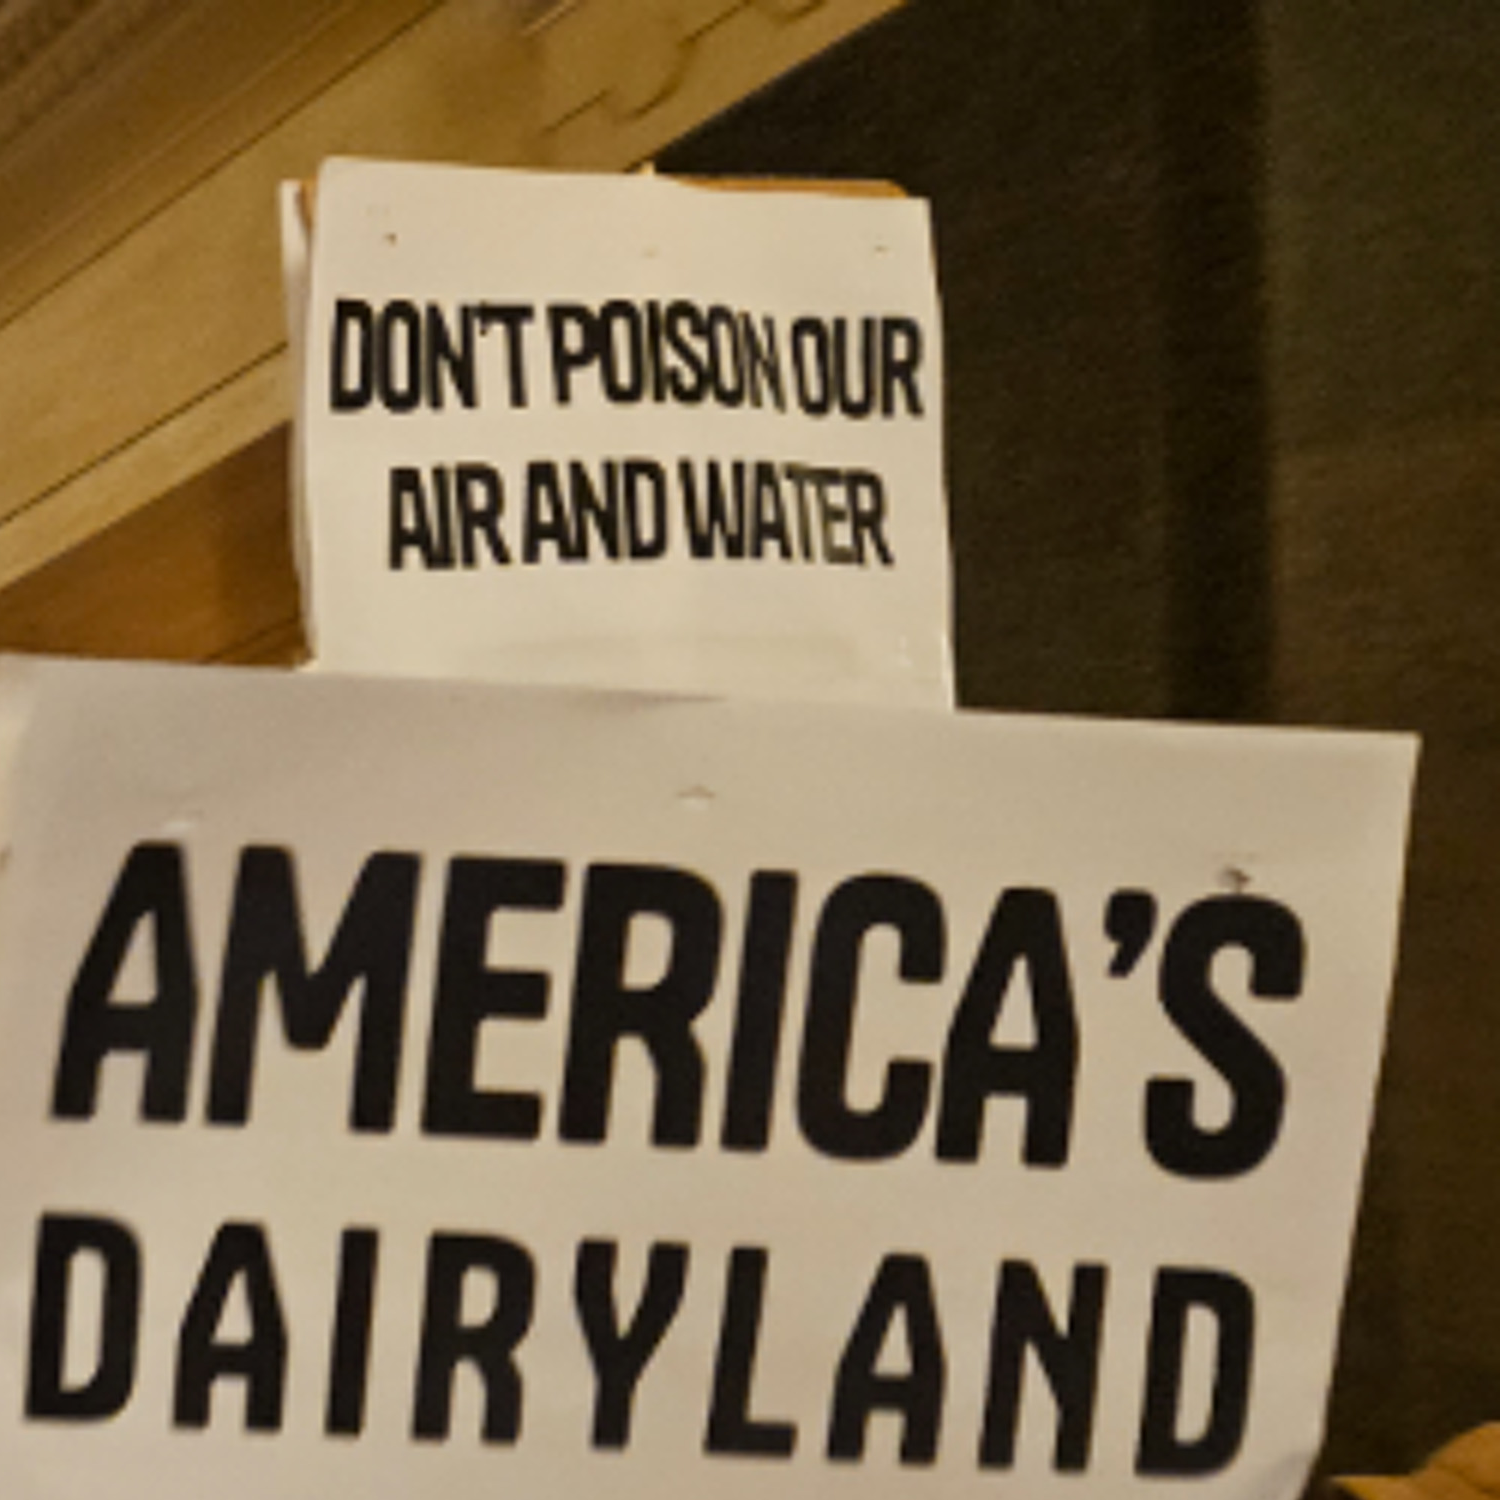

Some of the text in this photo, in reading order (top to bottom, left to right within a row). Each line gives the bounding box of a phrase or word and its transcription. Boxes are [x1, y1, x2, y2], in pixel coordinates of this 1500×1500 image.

[329, 297, 924, 419] DON'T POISON OUR
[388, 457, 895, 571] AIR AND WATER
[47, 839, 1307, 1182] AMERICA'S
[23, 1209, 1256, 1480] DAIRYLAND
